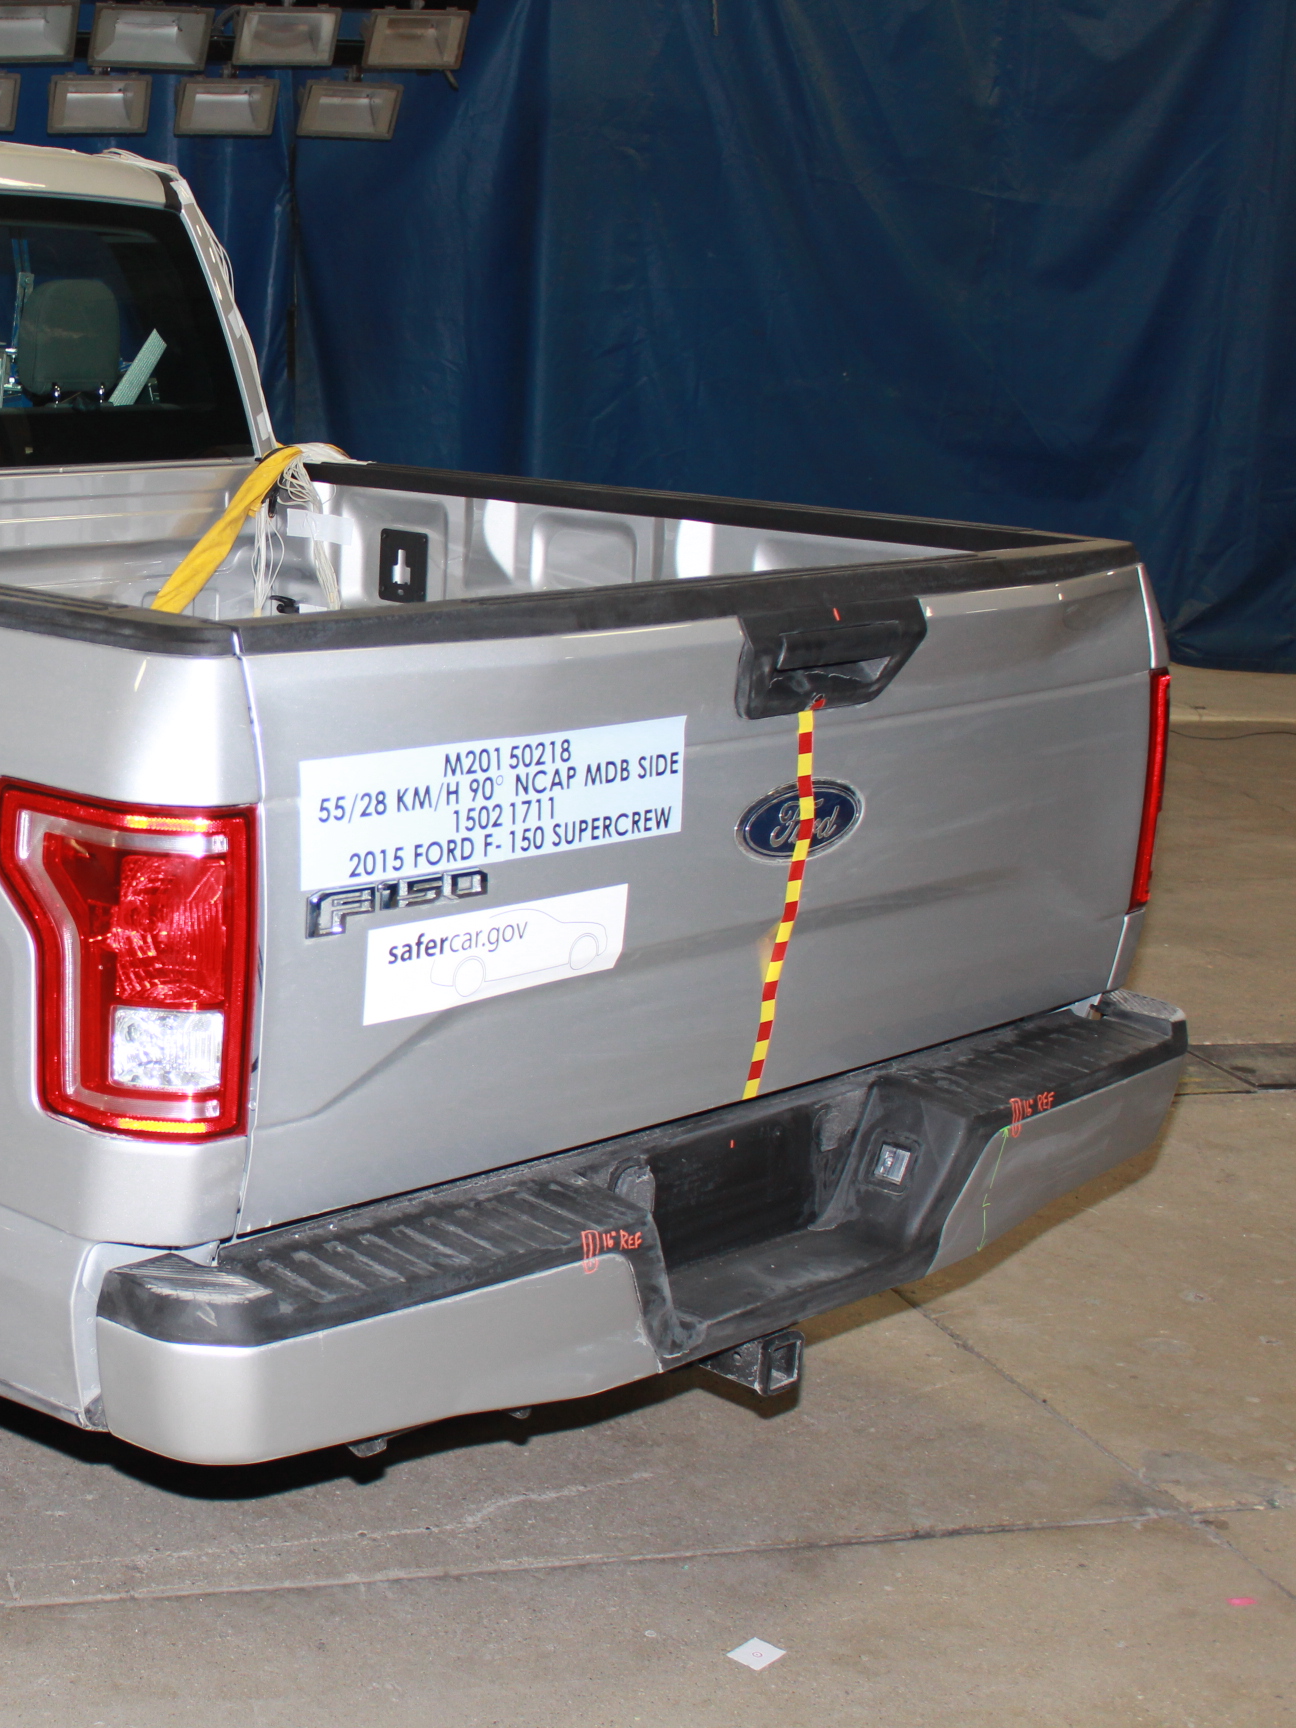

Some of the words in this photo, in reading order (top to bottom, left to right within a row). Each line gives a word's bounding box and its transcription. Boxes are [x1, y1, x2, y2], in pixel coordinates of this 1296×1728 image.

[443, 738, 572, 778] M20150218
[317, 789, 388, 824] 55/28
[396, 781, 460, 812] KM/H
[468, 774, 504, 803] 90°
[514, 766, 577, 797] NCAP
[584, 758, 631, 788] MDB
[637, 751, 680, 778] SIDE
[452, 796, 556, 834] 15021711
[348, 846, 404, 878] 2015
[413, 836, 475, 868] FORD
[484, 826, 545, 857] F-150
[551, 805, 673, 848] SUPERCREW
[387, 920, 529, 965] safercar.gov
[1037, 1091, 1056, 1112] REF
[619, 1228, 643, 1251] REF
